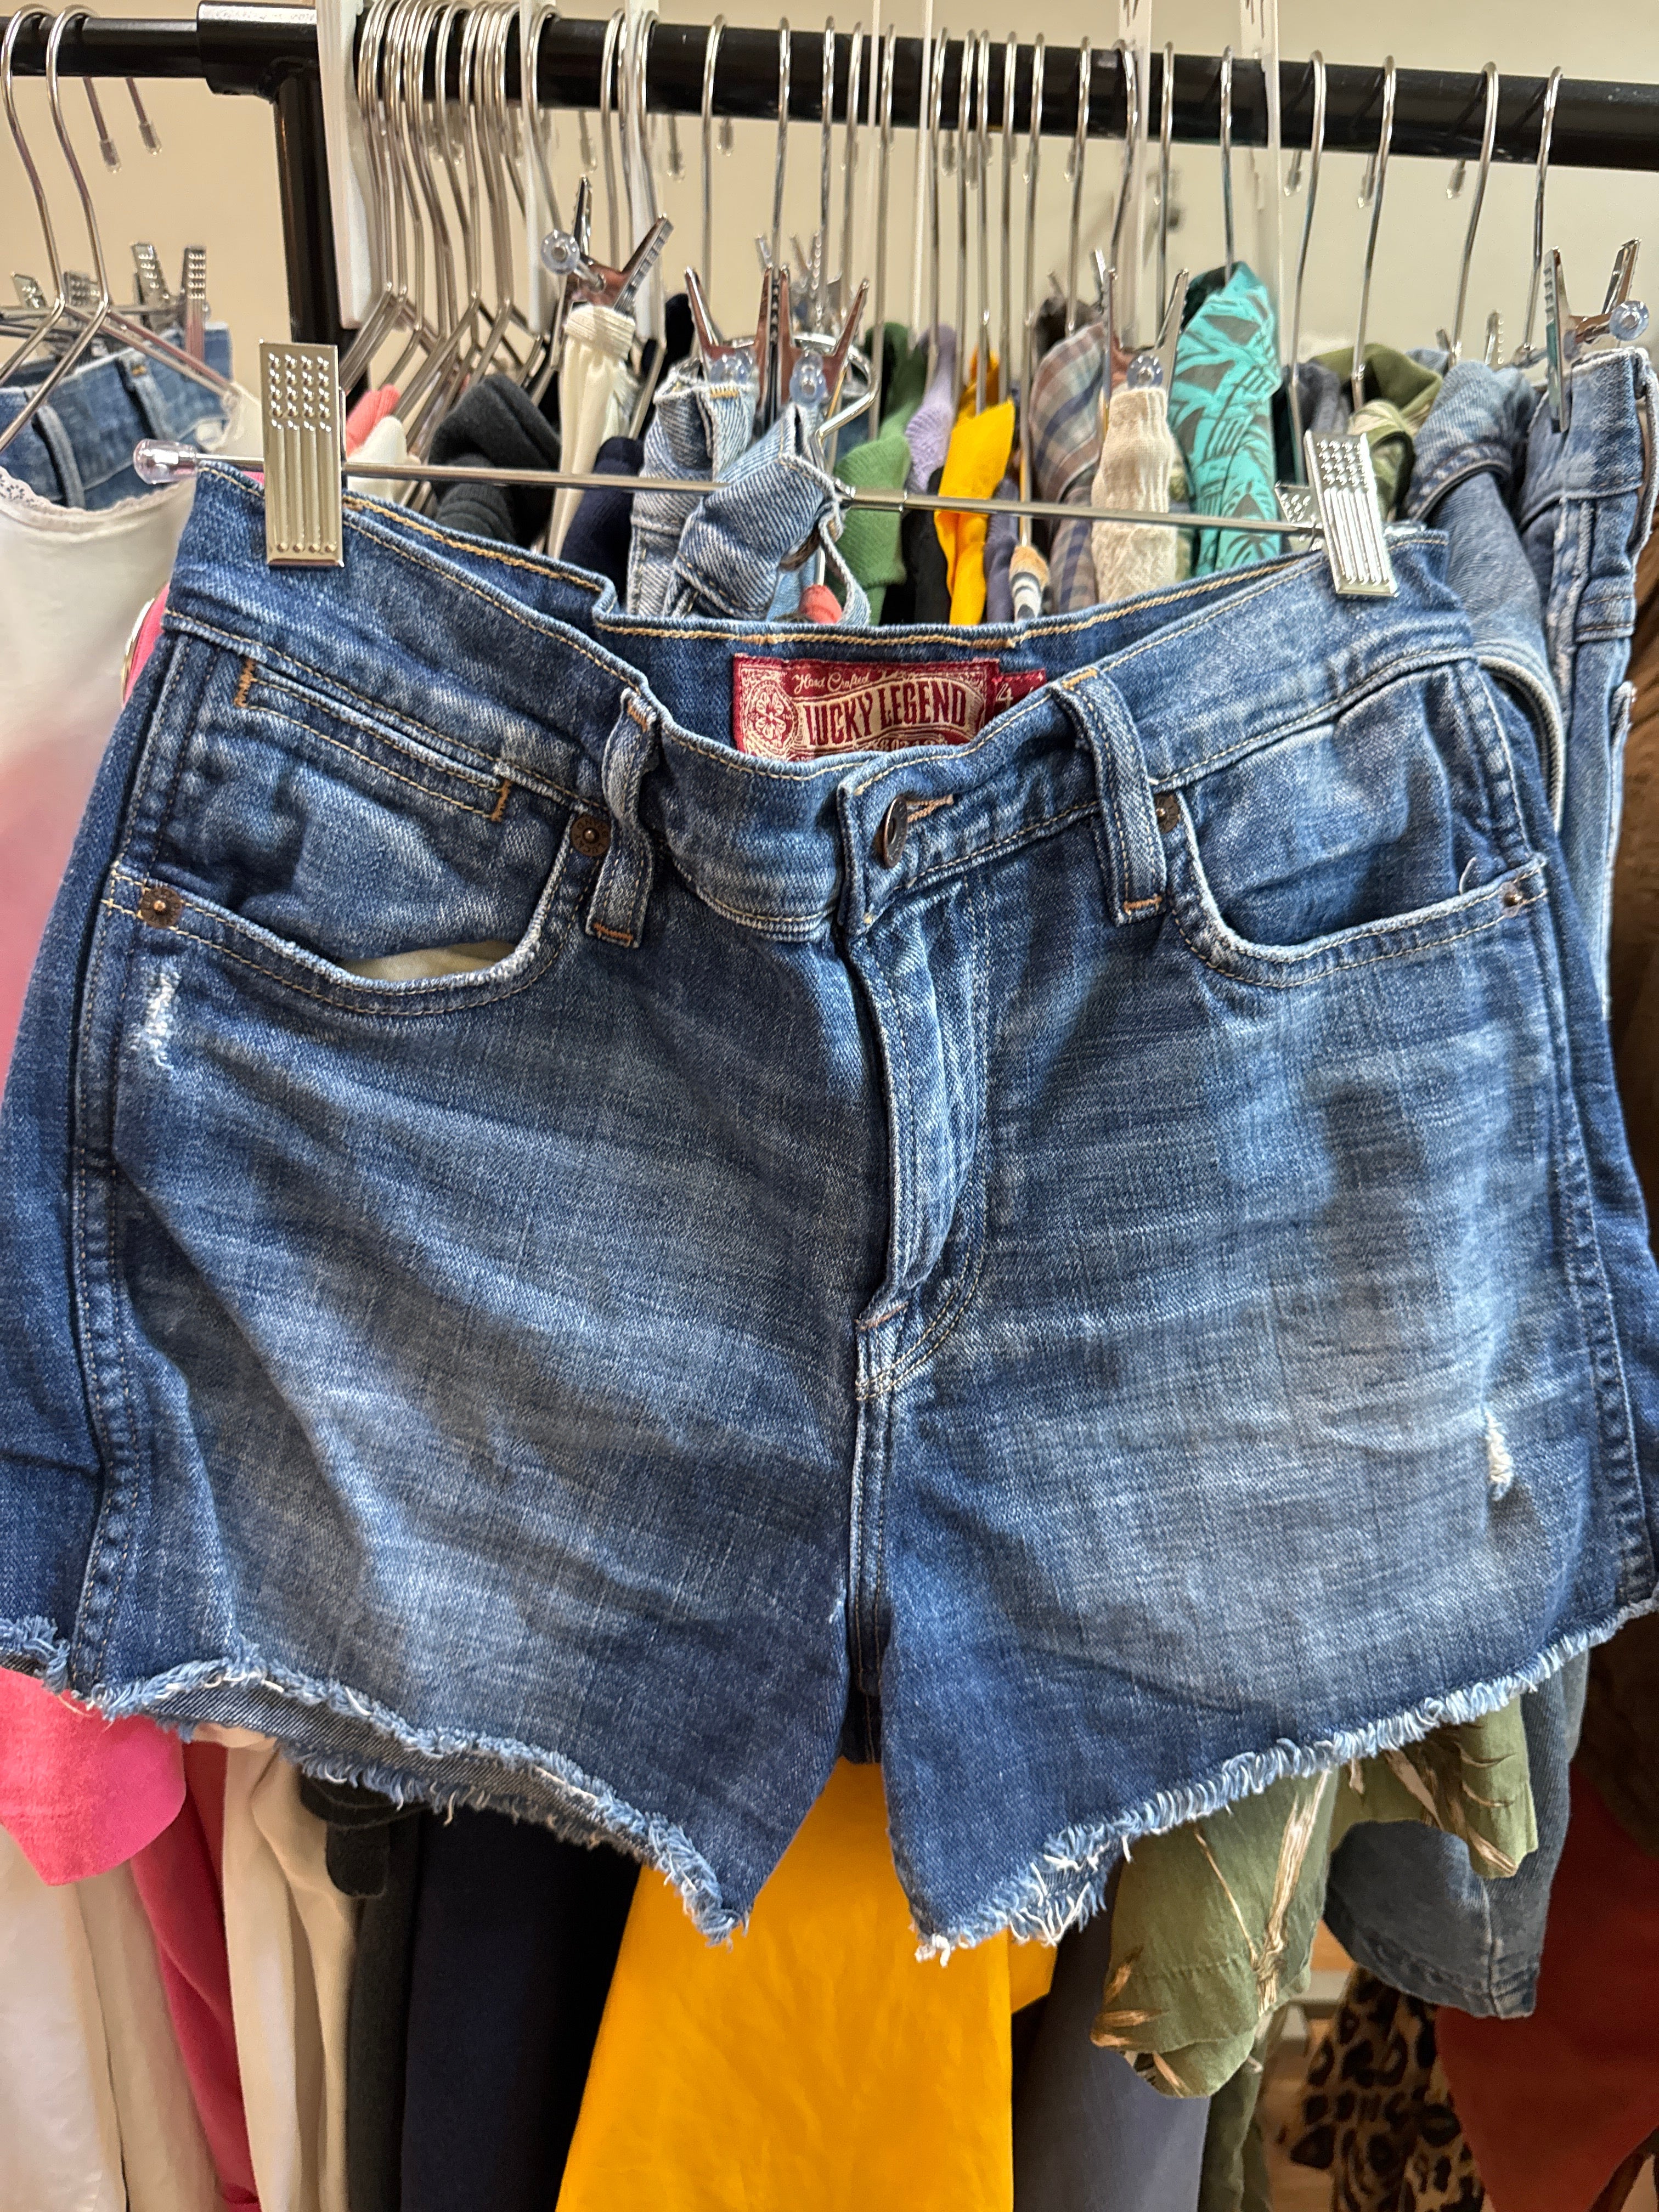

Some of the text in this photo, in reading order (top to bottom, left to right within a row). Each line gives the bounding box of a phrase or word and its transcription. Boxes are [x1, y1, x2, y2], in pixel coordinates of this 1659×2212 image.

[792, 670, 870, 695] Hand Crafted
[995, 682, 1014, 709] 4
[803, 680, 966, 745] LUCKY LEGEND
